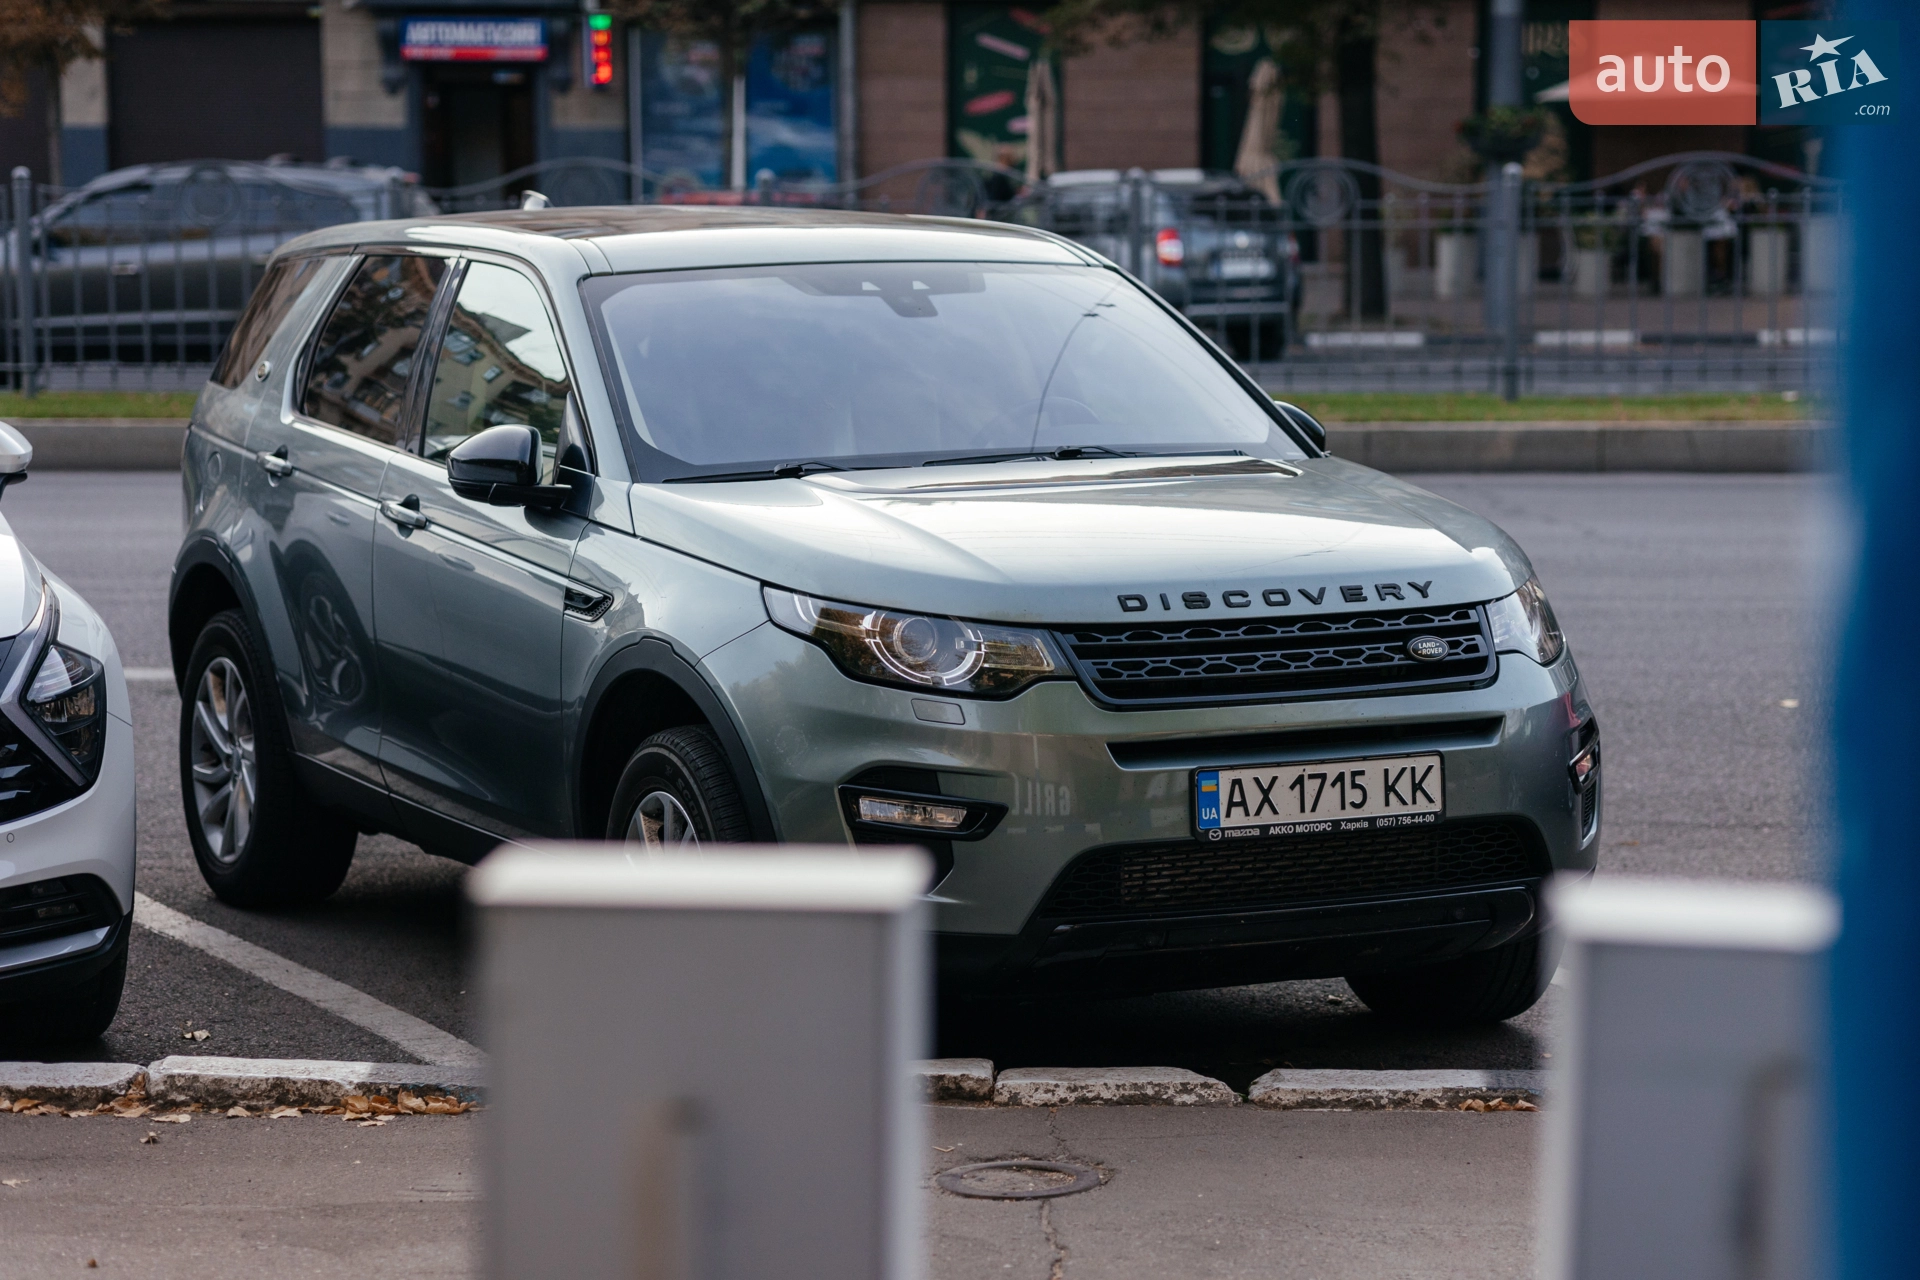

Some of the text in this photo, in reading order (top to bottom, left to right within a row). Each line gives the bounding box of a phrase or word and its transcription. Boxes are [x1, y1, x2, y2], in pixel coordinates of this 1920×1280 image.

[1117, 580, 1433, 612] DISCOVERY
[1225, 764, 1436, 818] AX 1715 KK
[1202, 807, 1218, 820] UA
[1268, 813, 1435, 835] АККО МОТОРС Харків (057) 756-44-00
